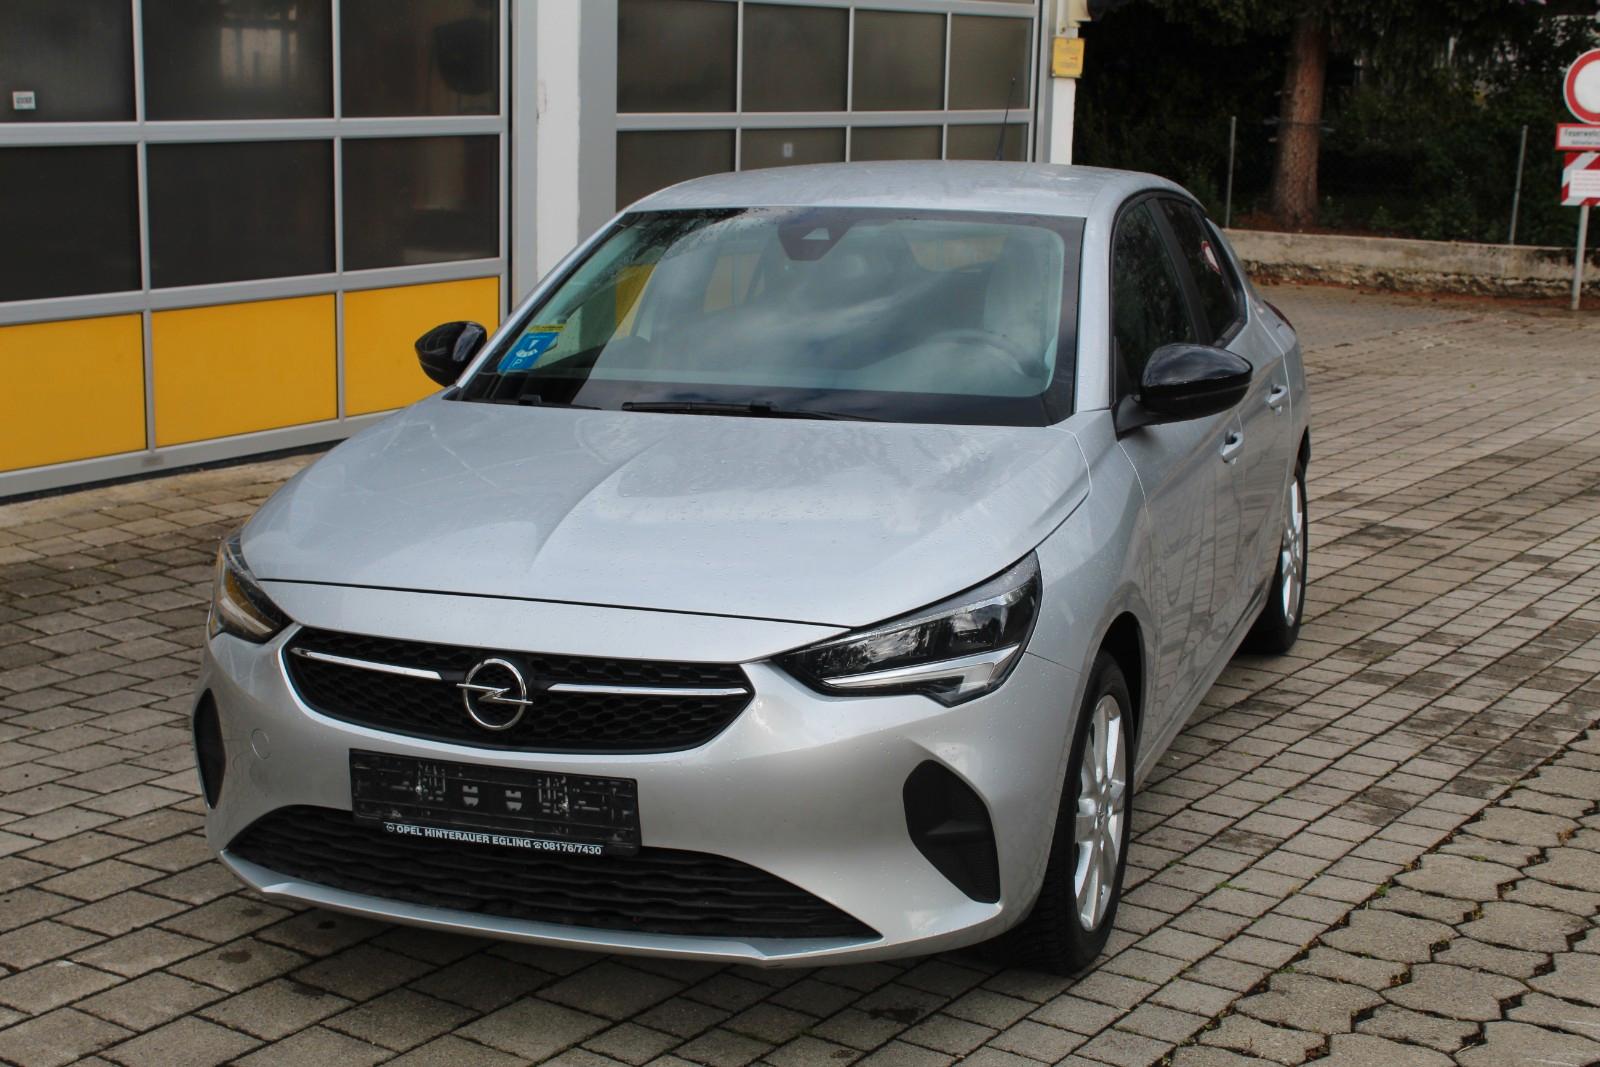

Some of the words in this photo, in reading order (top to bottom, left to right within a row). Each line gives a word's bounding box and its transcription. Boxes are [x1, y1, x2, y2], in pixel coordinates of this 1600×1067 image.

[396, 825, 422, 836] OPEL
[424, 829, 490, 844] HINTERAUER
[492, 836, 531, 848] EGLING
[542, 841, 602, 855] 08176/7430
